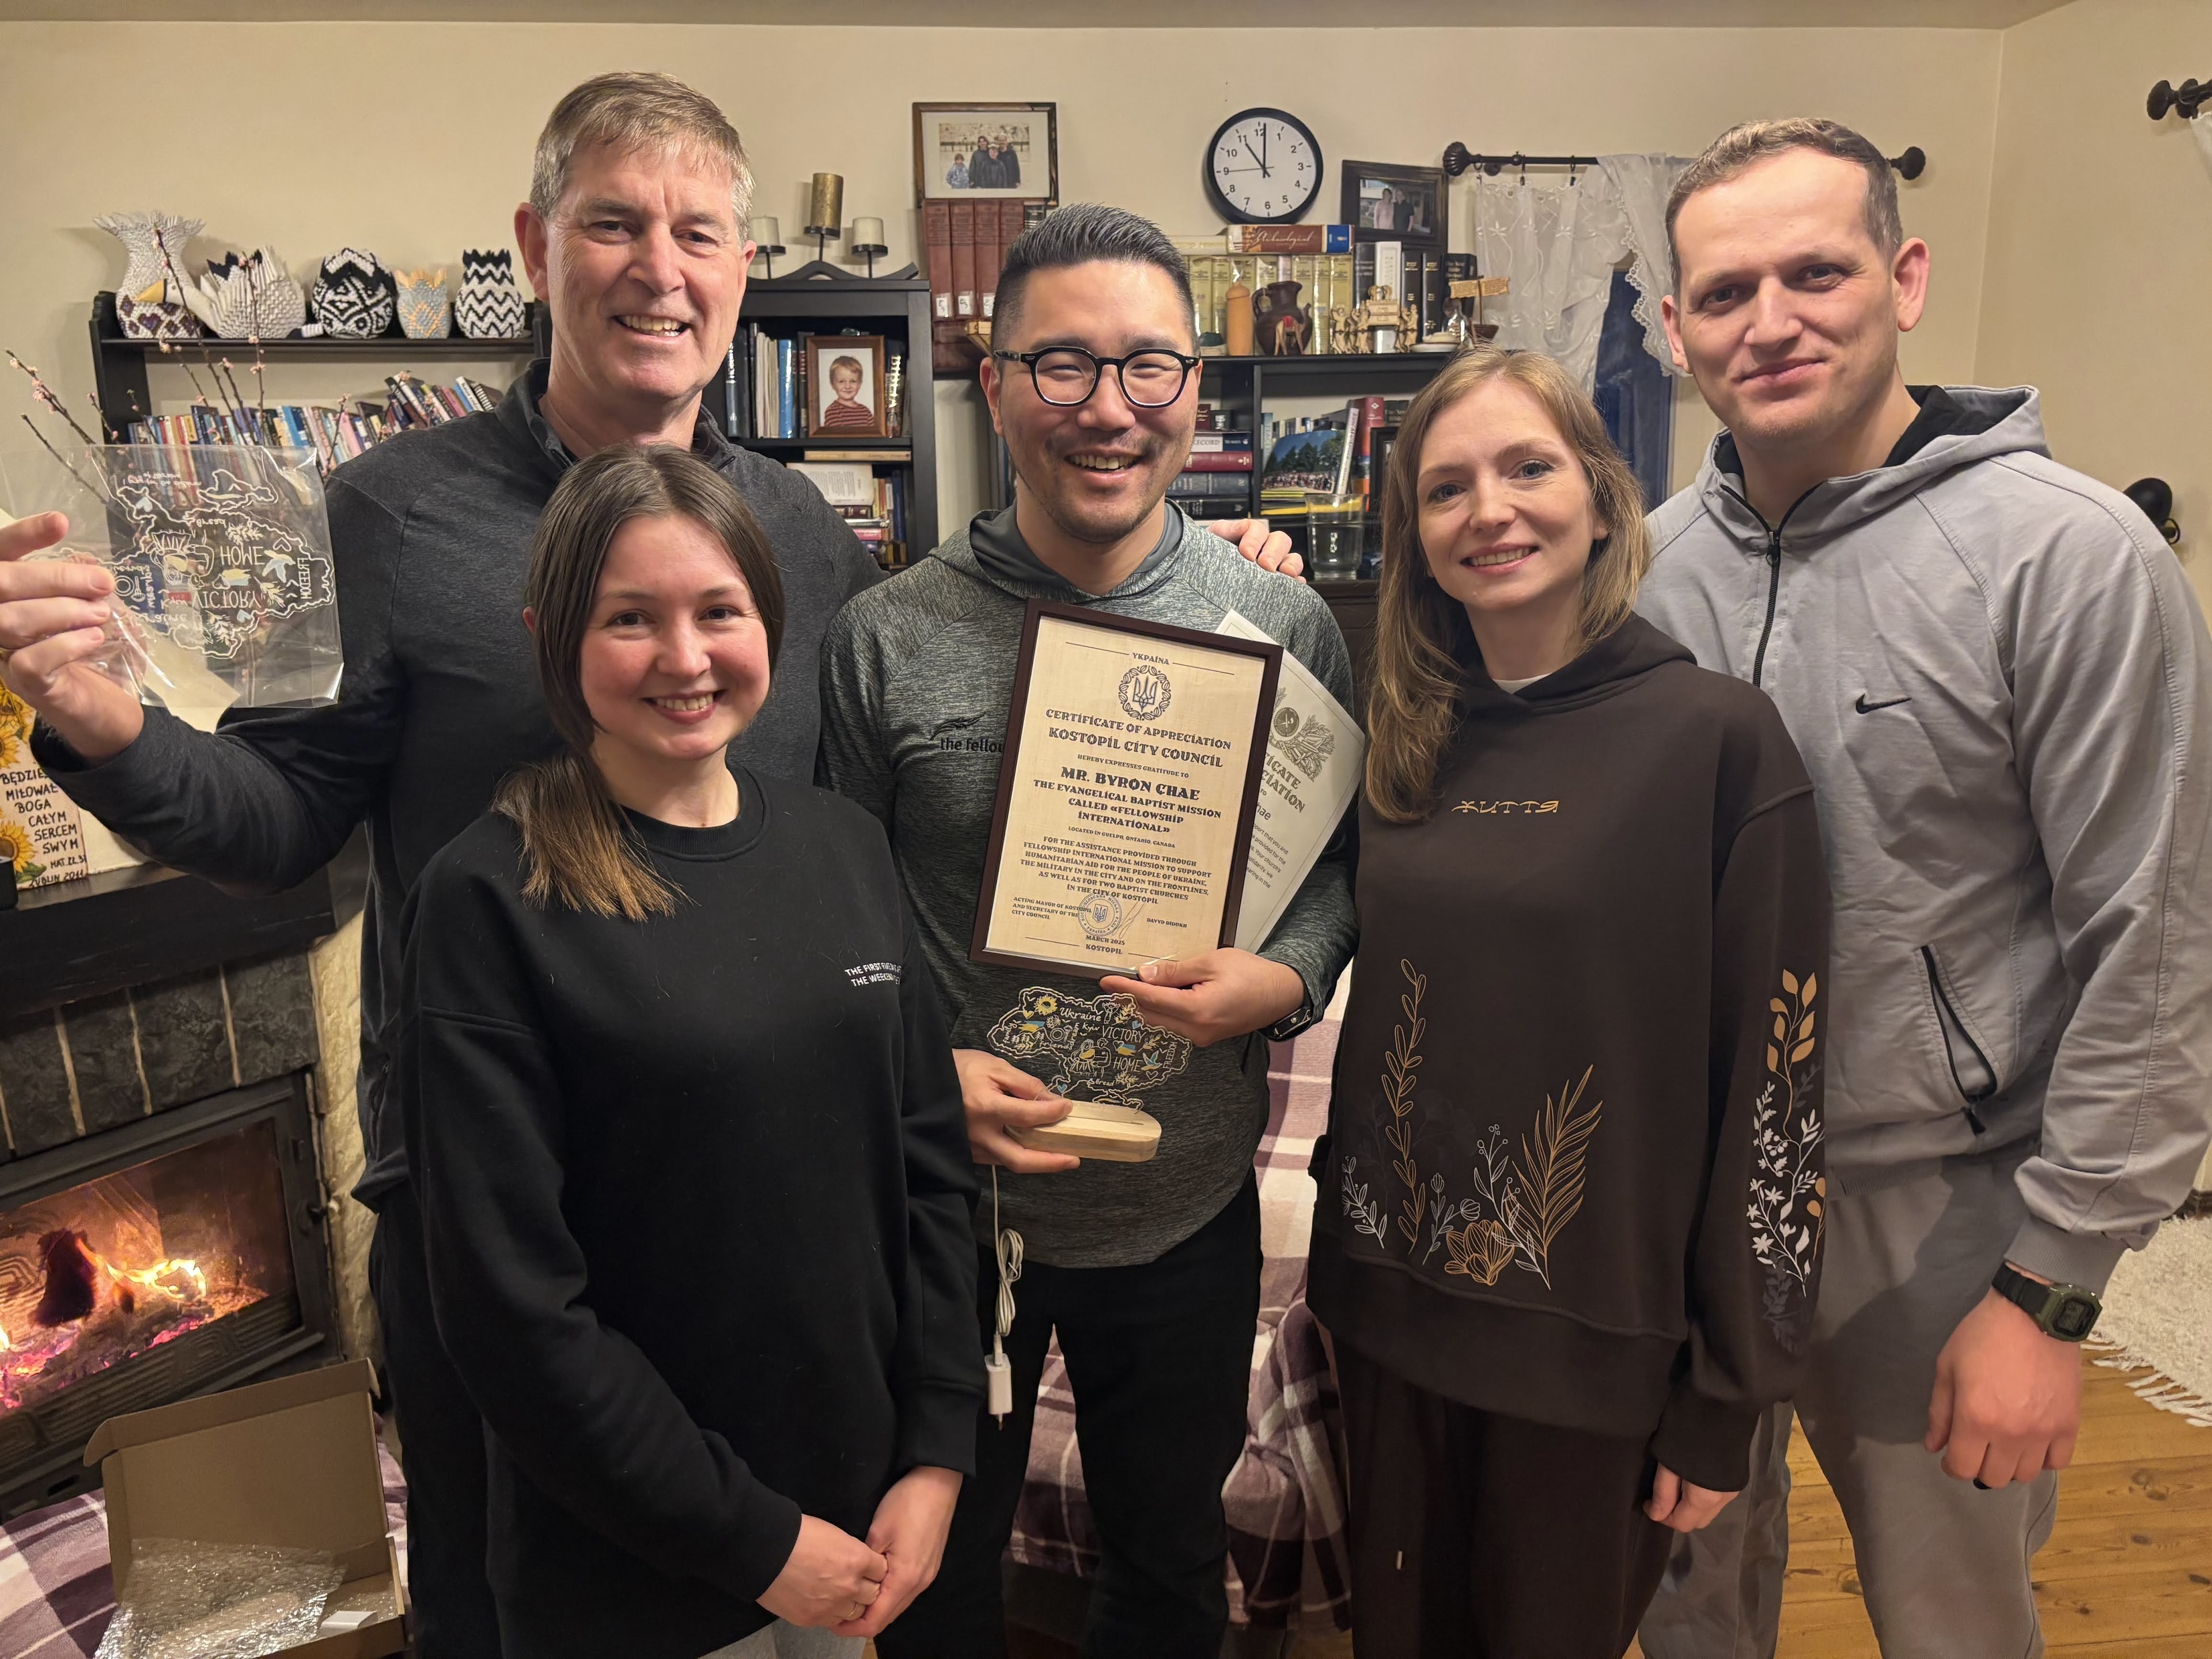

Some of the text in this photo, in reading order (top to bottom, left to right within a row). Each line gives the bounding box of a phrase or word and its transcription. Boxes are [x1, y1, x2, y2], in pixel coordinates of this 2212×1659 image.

[1238, 135, 1247, 143] 11
[1277, 132, 1281, 141] 1
[1226, 149, 1237, 157] 10
[1291, 145, 1297, 153] 2
[1223, 167, 1229, 175] 9
[1298, 162, 1304, 171] 3
[1229, 184, 1236, 192] 8
[1295, 180, 1300, 188] 4
[1244, 197, 1250, 206] 7
[1264, 202, 1271, 210] 6
[1282, 195, 1288, 203] 5
[1046, 707, 1230, 750] CERTIFICATE OF APPRECIATION
[941, 737, 962, 750] the
[1048, 726, 1224, 768] KOSTOPIL CITY COUNCIL
[1077, 753, 1104, 763] HEREBY
[1105, 759, 1142, 770] EXPRESSES
[1142, 765, 1179, 777] GRATITUDE
[1060, 766, 1200, 801] MR. BYRON CHAE
[14, 798, 52, 813] BOGA
[1032, 778, 1221, 819] THE EVANGELICAL BAPTIST MISSION
[1068, 796, 1184, 824] CALLED «FELLOWSHIP
[29, 811, 66, 827] CAŁYM
[1078, 810, 1171, 834] INTERNATIONAL»
[35, 824, 77, 842] SERCEM
[1068, 825, 1093, 834] LOCATED
[1125, 835, 1152, 844] ONTARIO,
[1153, 840, 1175, 848] CANADA
[43, 839, 78, 854] SWYM
[1043, 835, 1196, 866] FOR THE ASSISTANCE PROVIDED THROUGH
[1023, 841, 1071, 854] FELLOWSHIP
[1072, 849, 1132, 865] INTERNATIONAL
[1133, 859, 1165, 870] MISSION
[1177, 866, 1211, 878] SUPPORT
[1025, 850, 1084, 866] HUMANITARIAN
[1085, 860, 1099, 868] AID
[1100, 862, 1115, 871] FOR
[1116, 865, 1131, 873] THE
[1132, 868, 1161, 878] PEOPLE
[1173, 874, 1207, 886] UKRAINE,
[1020, 858, 1035, 866] THE
[1036, 861, 1073, 873] MILITARY
[1083, 869, 1099, 877] THE
[1100, 872, 1117, 880] CITY
[1118, 874, 1134, 882] AND
[1146, 879, 1162, 887] THE
[1162, 882, 1209, 895] FRONTLINES,
[1050, 872, 1070, 881] WELL
[1082, 877, 1097, 885] FOR
[1098, 880, 1115, 888] TWO
[1116, 883, 1149, 893] BAPTIST
[1149, 888, 1188, 900] CHURCHES
[1076, 885, 1092, 893] THE
[1092, 888, 1110, 896] CITY
[1122, 893, 1159, 904] KOSTOPIL
[1013, 895, 1035, 904] ACTING
[1035, 899, 1055, 907] MAYOR
[1065, 903, 1092, 913] KOSTOPIL
[1025, 904, 1058, 915] SECRETARY
[1026, 911, 1050, 919] COUNCIL
[1085, 934, 1109, 942] MARCH
[1085, 944, 1123, 955] KOSTOPIL
[844, 966, 863, 976] THE
[863, 962, 882, 972] FIRST
[851, 976, 869, 986] THE
[1060, 1007, 1101, 1021] Ukraine
[1003, 1022, 1017, 1043] family
[1067, 1022, 1080, 1046] dream
[1082, 1022, 1100, 1032] Kyiv
[1102, 1025, 1146, 1043] VICTORY
[1039, 1040, 1073, 1051] friends
[1162, 1041, 1178, 1069] FREEDOM
[1113, 1057, 1143, 1073] HOME
